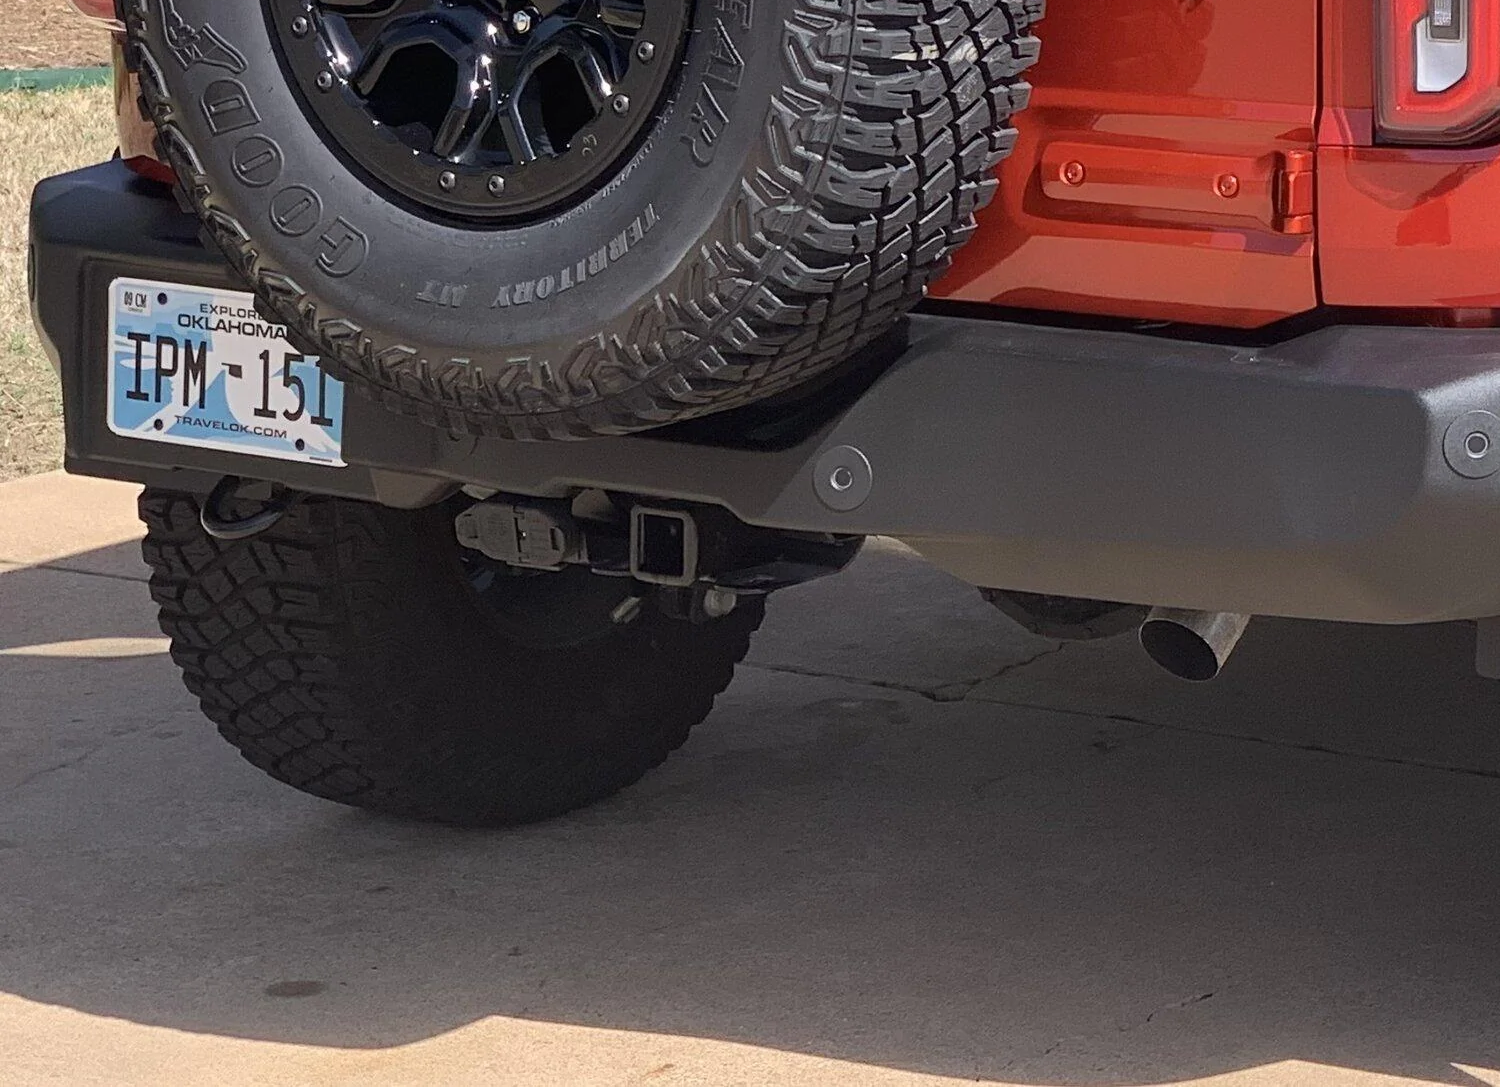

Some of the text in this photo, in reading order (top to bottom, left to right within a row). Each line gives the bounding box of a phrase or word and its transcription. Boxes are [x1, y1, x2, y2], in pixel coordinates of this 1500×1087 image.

[490, 202, 661, 309] TERRITORY
[199, 303, 263, 321] EXPLOR
[177, 313, 288, 340] OKLAHOMA
[173, 415, 288, 439] TRAVELOK.COM
